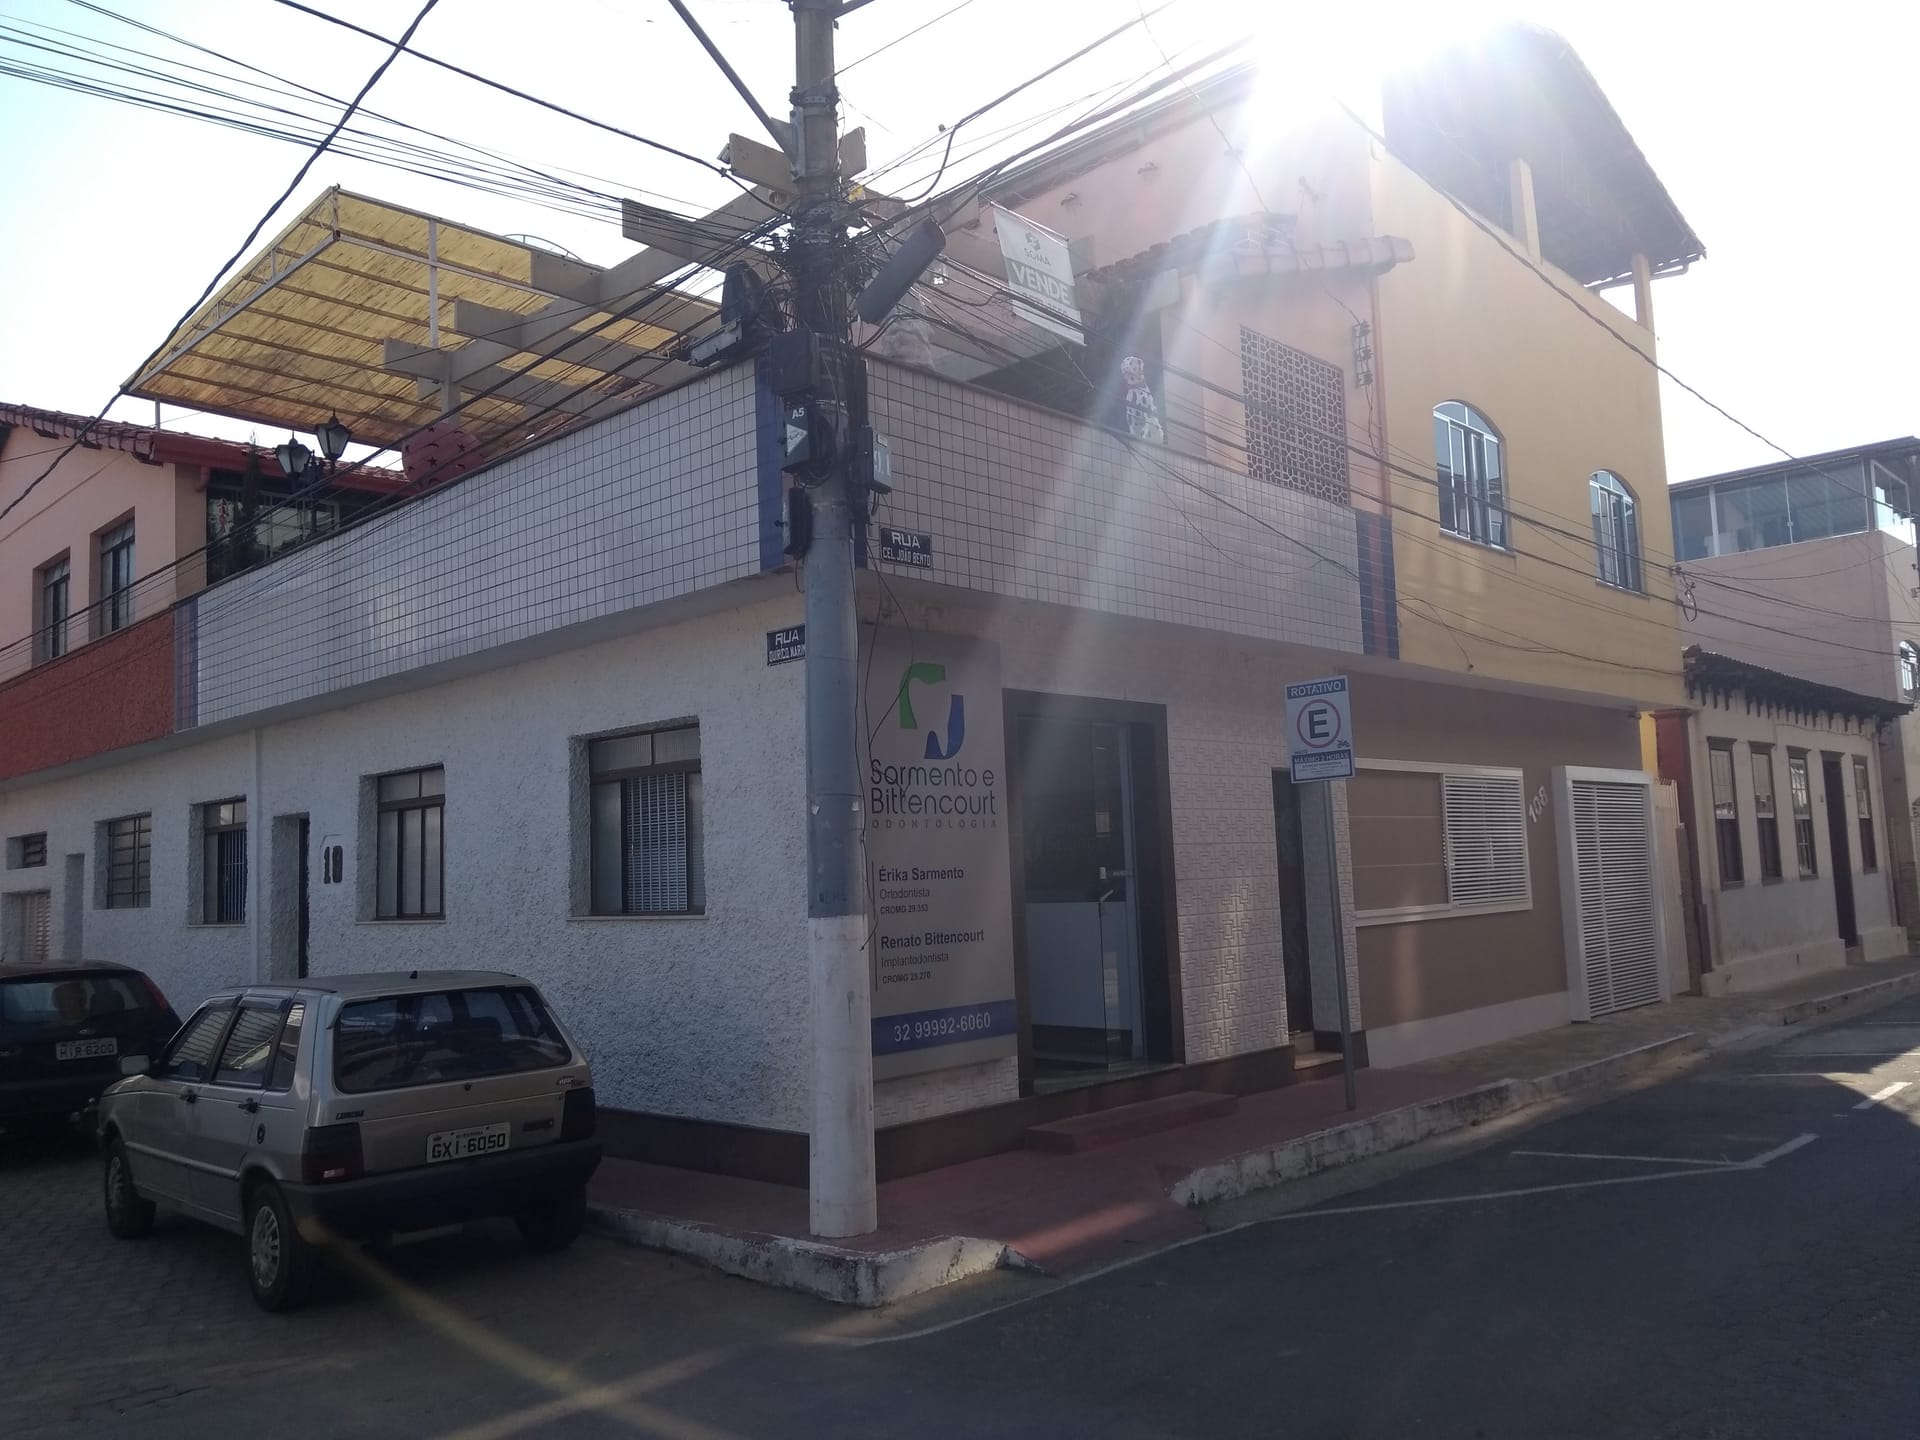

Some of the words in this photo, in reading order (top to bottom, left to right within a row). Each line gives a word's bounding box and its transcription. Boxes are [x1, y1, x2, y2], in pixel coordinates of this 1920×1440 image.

[1011, 262, 1071, 305] VENDE
[891, 531, 920, 549] RUA
[912, 551, 931, 567] BENTO
[775, 629, 799, 645] RUA
[1291, 680, 1342, 697] ROTATIVO
[1307, 708, 1329, 739] E
[871, 759, 977, 787] Sarmento
[982, 769, 994, 786] e
[871, 787, 996, 815] Bittencourt
[1529, 785, 1548, 823] 108
[872, 819, 997, 829] ODONTOLOGIA
[879, 865, 908, 882] Érika
[911, 867, 964, 881] Sarmento
[880, 887, 930, 900] Ortodontista
[880, 905, 906, 915] CROMG
[881, 934, 921, 950] Renato
[925, 929, 984, 946] Bittencourt
[881, 952, 949, 969] Implantodontista
[882, 973, 909, 985] CROMG
[894, 1023, 910, 1042] 32
[915, 1011, 991, 1039] 99992-6060
